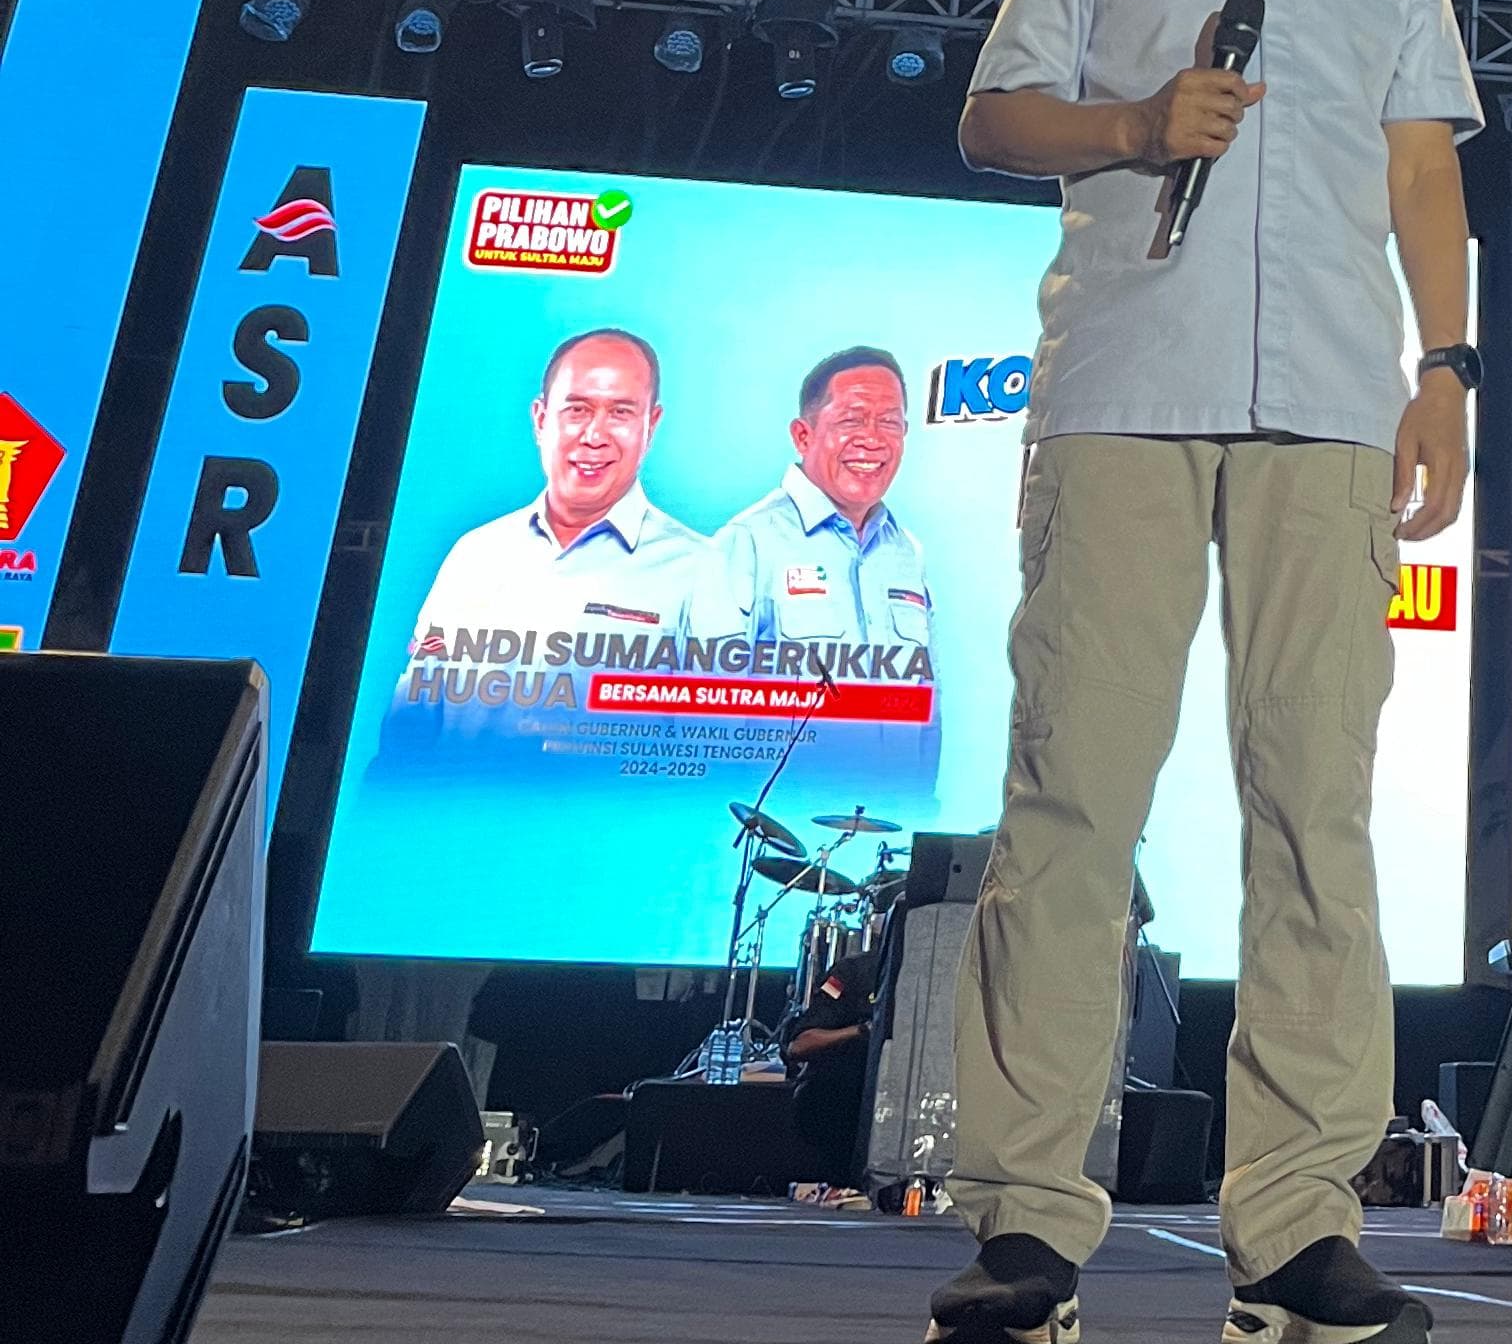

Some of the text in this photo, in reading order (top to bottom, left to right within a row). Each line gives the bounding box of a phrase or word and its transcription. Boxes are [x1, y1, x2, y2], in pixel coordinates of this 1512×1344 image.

[481, 195, 590, 227] PILIHAN
[476, 221, 610, 255] PRABOWO
[475, 249, 605, 266] UNTUK SULTRA MAJU
[409, 624, 935, 681] ANDI SUMANGERUKKA
[407, 667, 578, 710] HUGUA
[600, 683, 826, 710] BERSAMA SULTRA MAJU
[577, 720, 662, 739] GUBERNUR
[664, 725, 677, 739] &
[681, 725, 730, 741] WAKIL
[733, 728, 817, 744] GUBERNUR
[620, 741, 700, 758] SULAWESI
[703, 745, 787, 761] TENGGARA
[620, 760, 706, 777] 2024-2029
